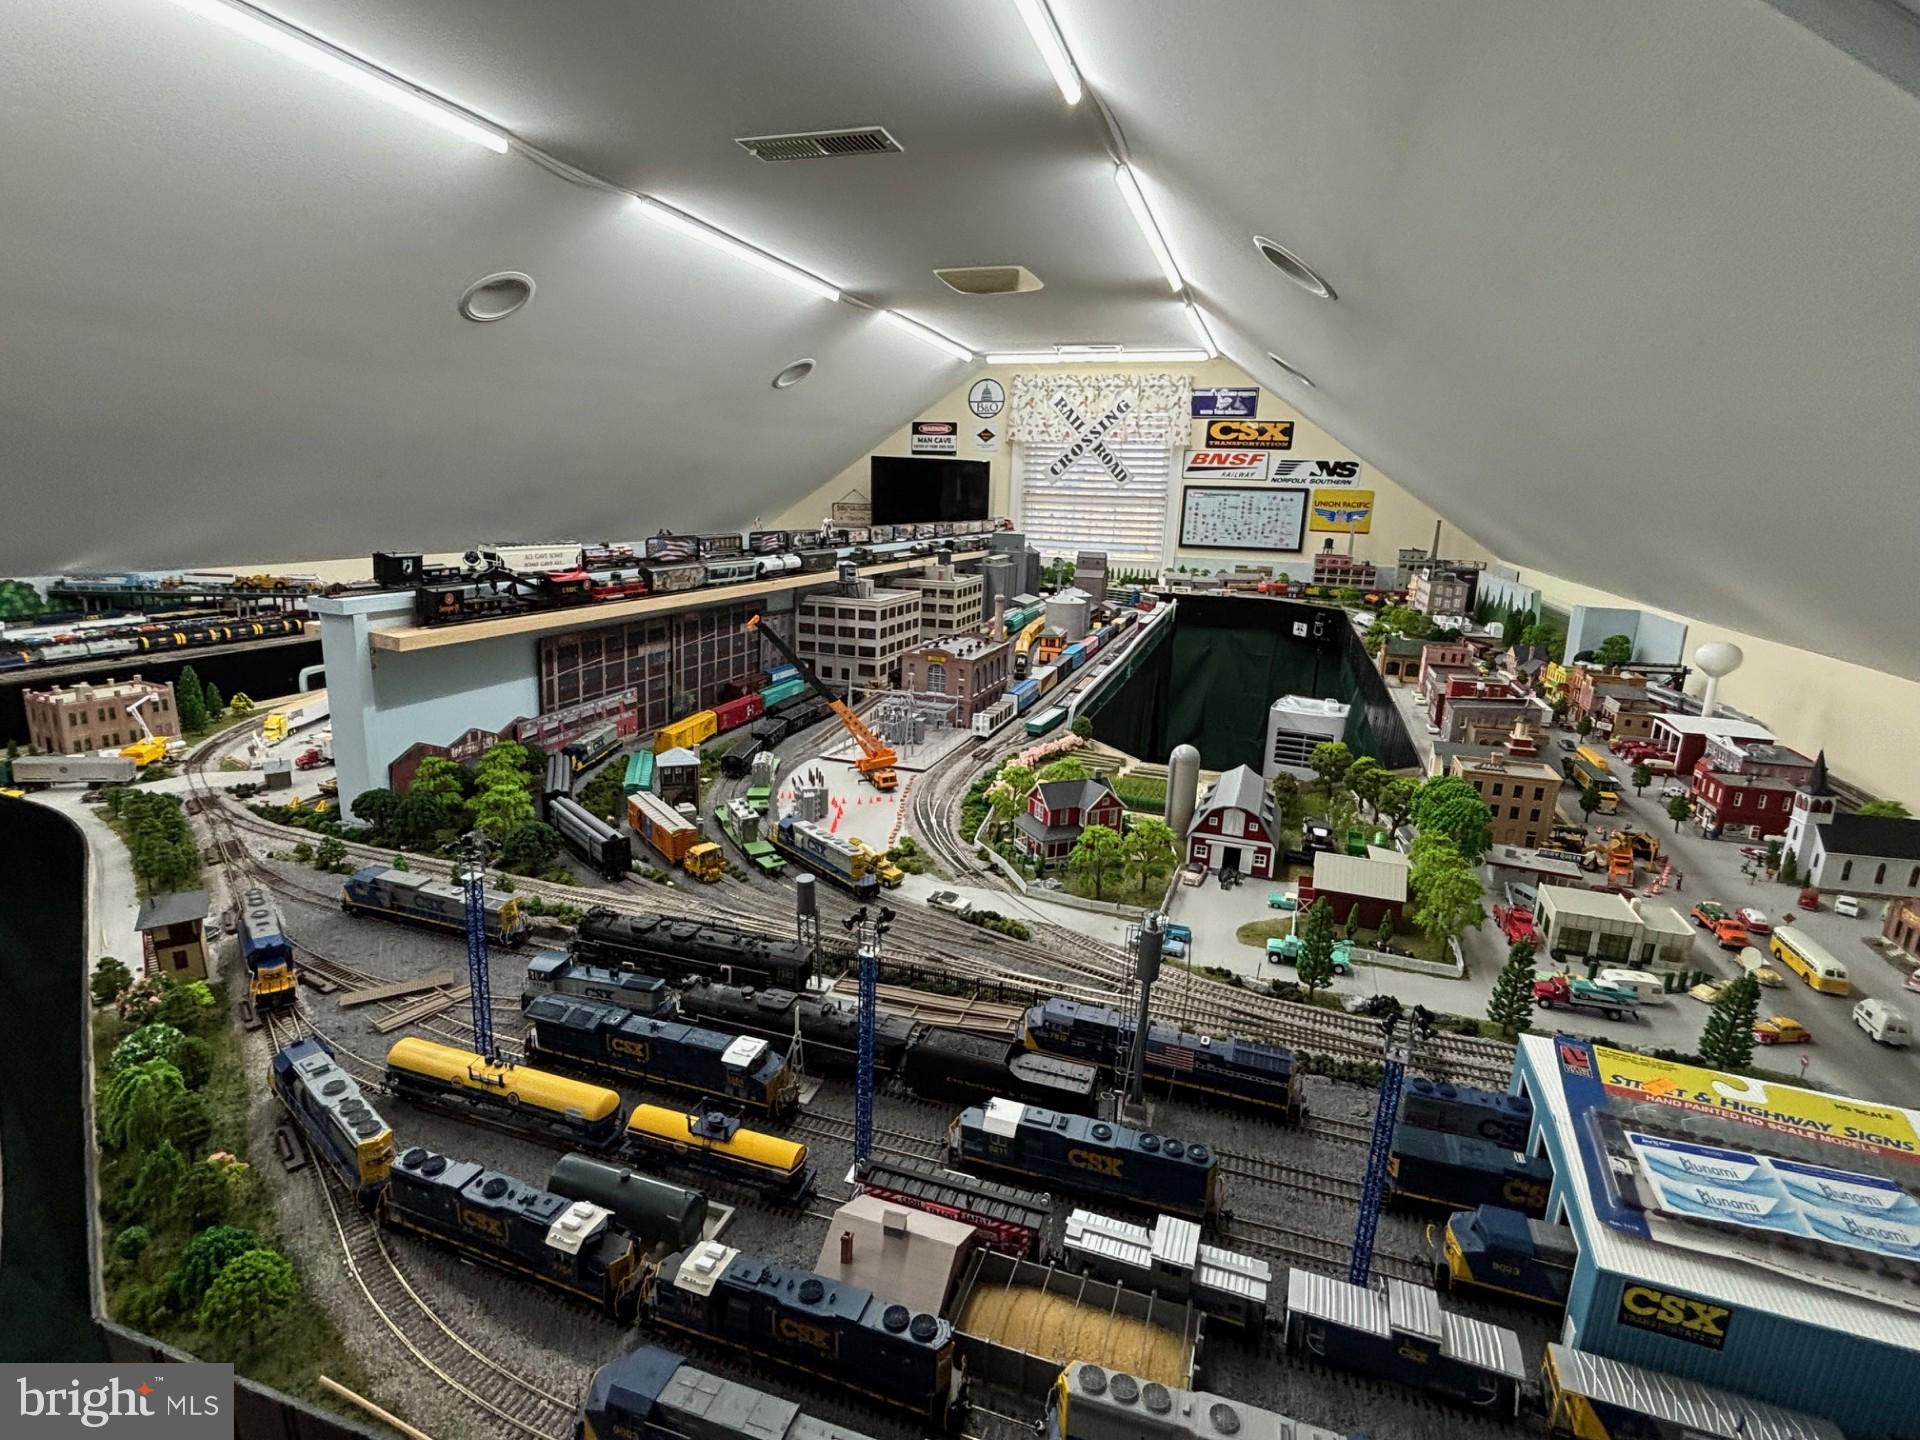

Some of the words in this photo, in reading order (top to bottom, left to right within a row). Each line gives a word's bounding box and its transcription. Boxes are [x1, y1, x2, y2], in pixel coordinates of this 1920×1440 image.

[976, 402, 999, 412] B&O
[1050, 400, 1132, 476] CROSSING
[1209, 421, 1290, 441] CSX
[1190, 453, 1266, 466] BNSF
[1309, 460, 1359, 478] NS
[1314, 500, 1341, 508] UNION
[1342, 500, 1371, 509] PACIFIC
[414, 895, 446, 914] CSX
[585, 987, 615, 999] CSX
[611, 1037, 646, 1057] CSX
[1609, 1074, 1688, 1098] STRT
[1694, 1091, 1712, 1103] &
[1720, 1097, 1833, 1132] HIGHWAY
[1844, 1126, 1915, 1152] SIGNS
[1853, 1107, 1894, 1120] SCALE
[1478, 1117, 1525, 1143] CS
[1645, 1094, 1683, 1108] HAND
[1684, 1102, 1740, 1120] PAINTED
[1767, 1122, 1817, 1140] SCALE
[1819, 1134, 1880, 1154] MODELS
[1067, 1148, 1125, 1177] CSX
[1503, 1176, 1546, 1208] CS
[1623, 1286, 1729, 1337] CSX
[779, 1318, 831, 1349] CSX
